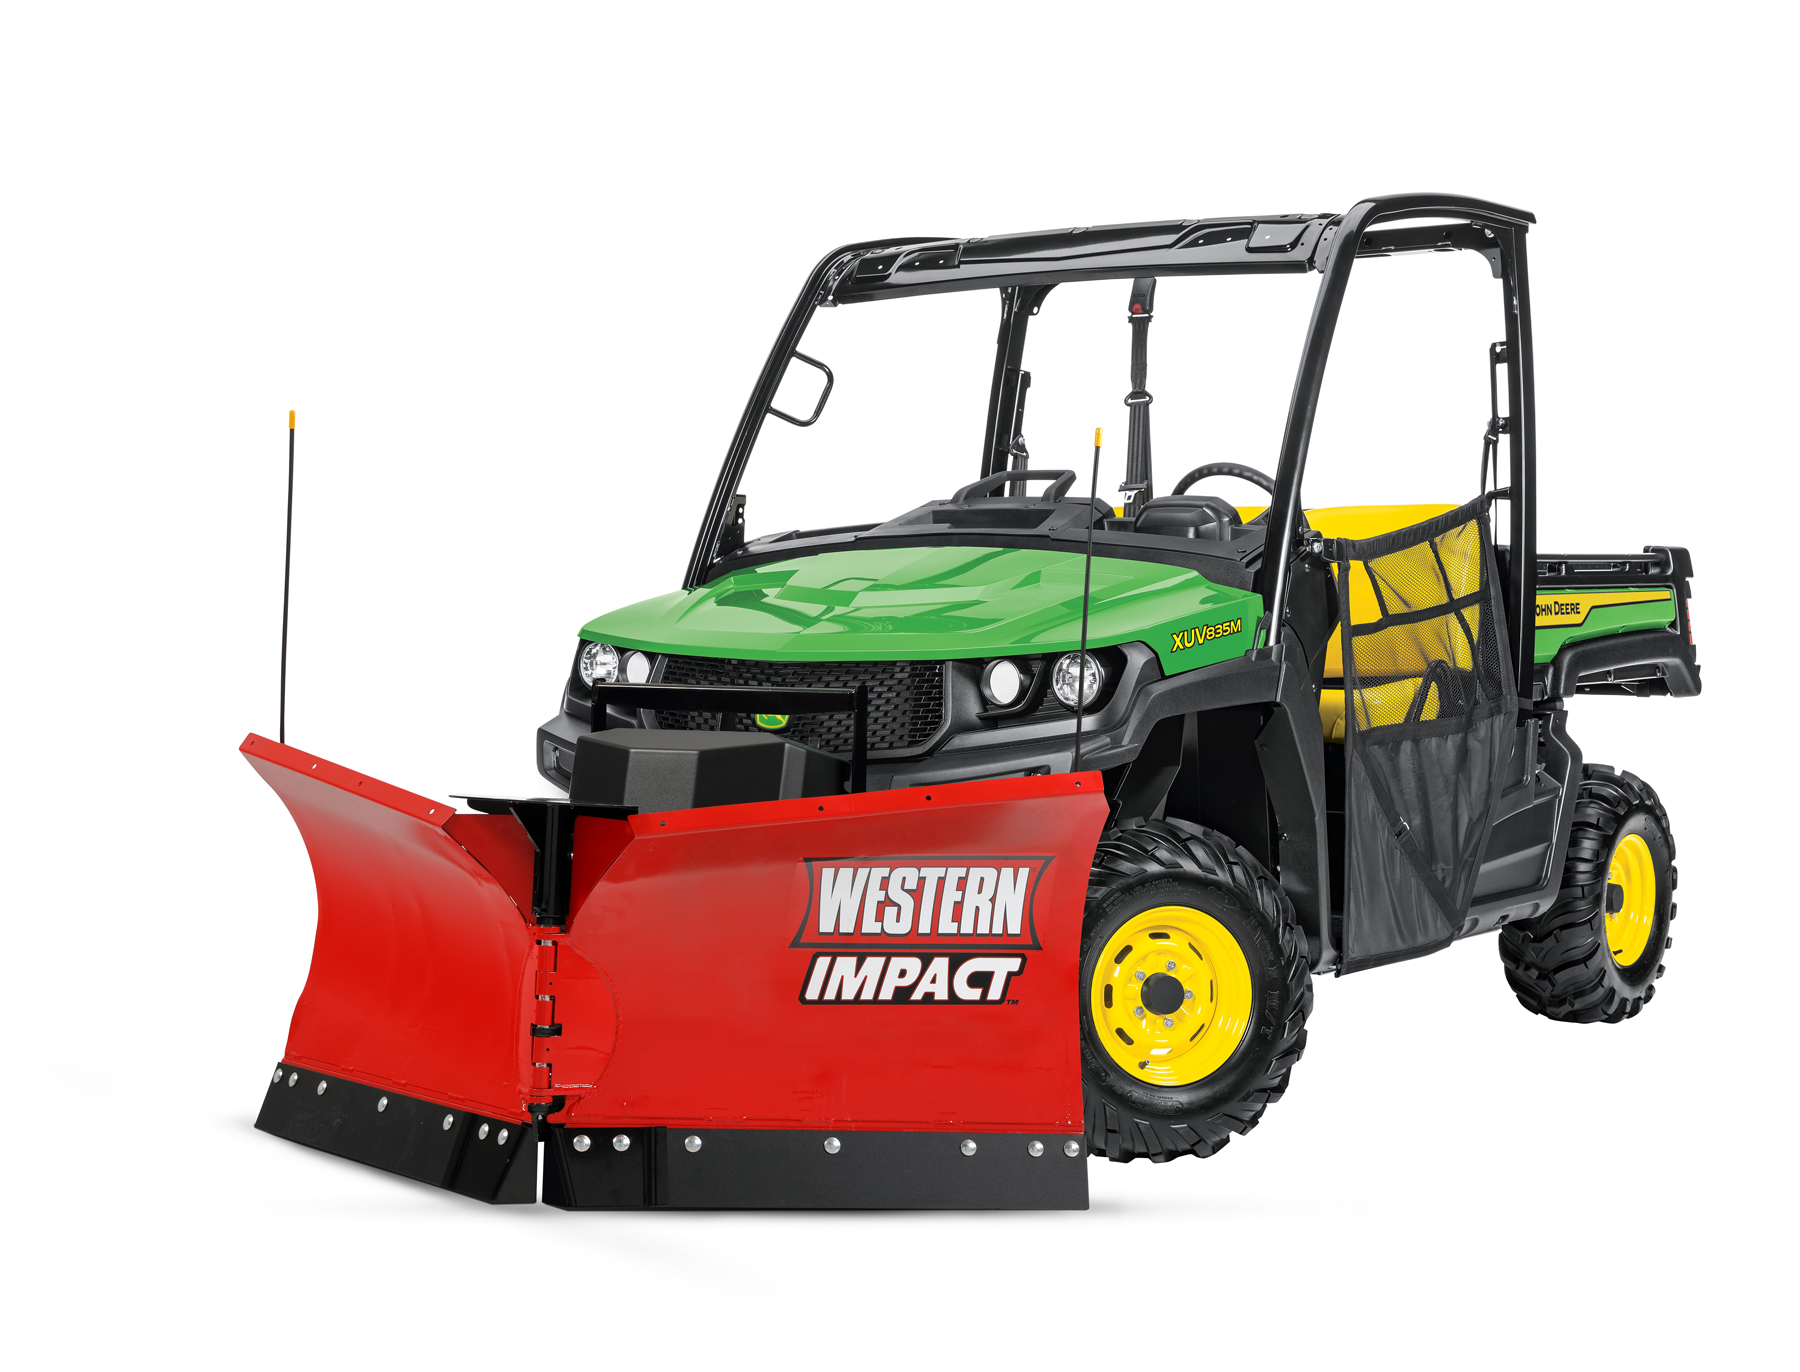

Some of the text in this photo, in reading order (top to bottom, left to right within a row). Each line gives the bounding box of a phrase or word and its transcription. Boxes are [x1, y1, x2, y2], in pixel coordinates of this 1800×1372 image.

[1535, 600, 1581, 617] OHN DEERE
[1170, 618, 1242, 653] XUV835M
[818, 867, 1031, 937] WESTERN
[804, 956, 1022, 1001] IMPACT
